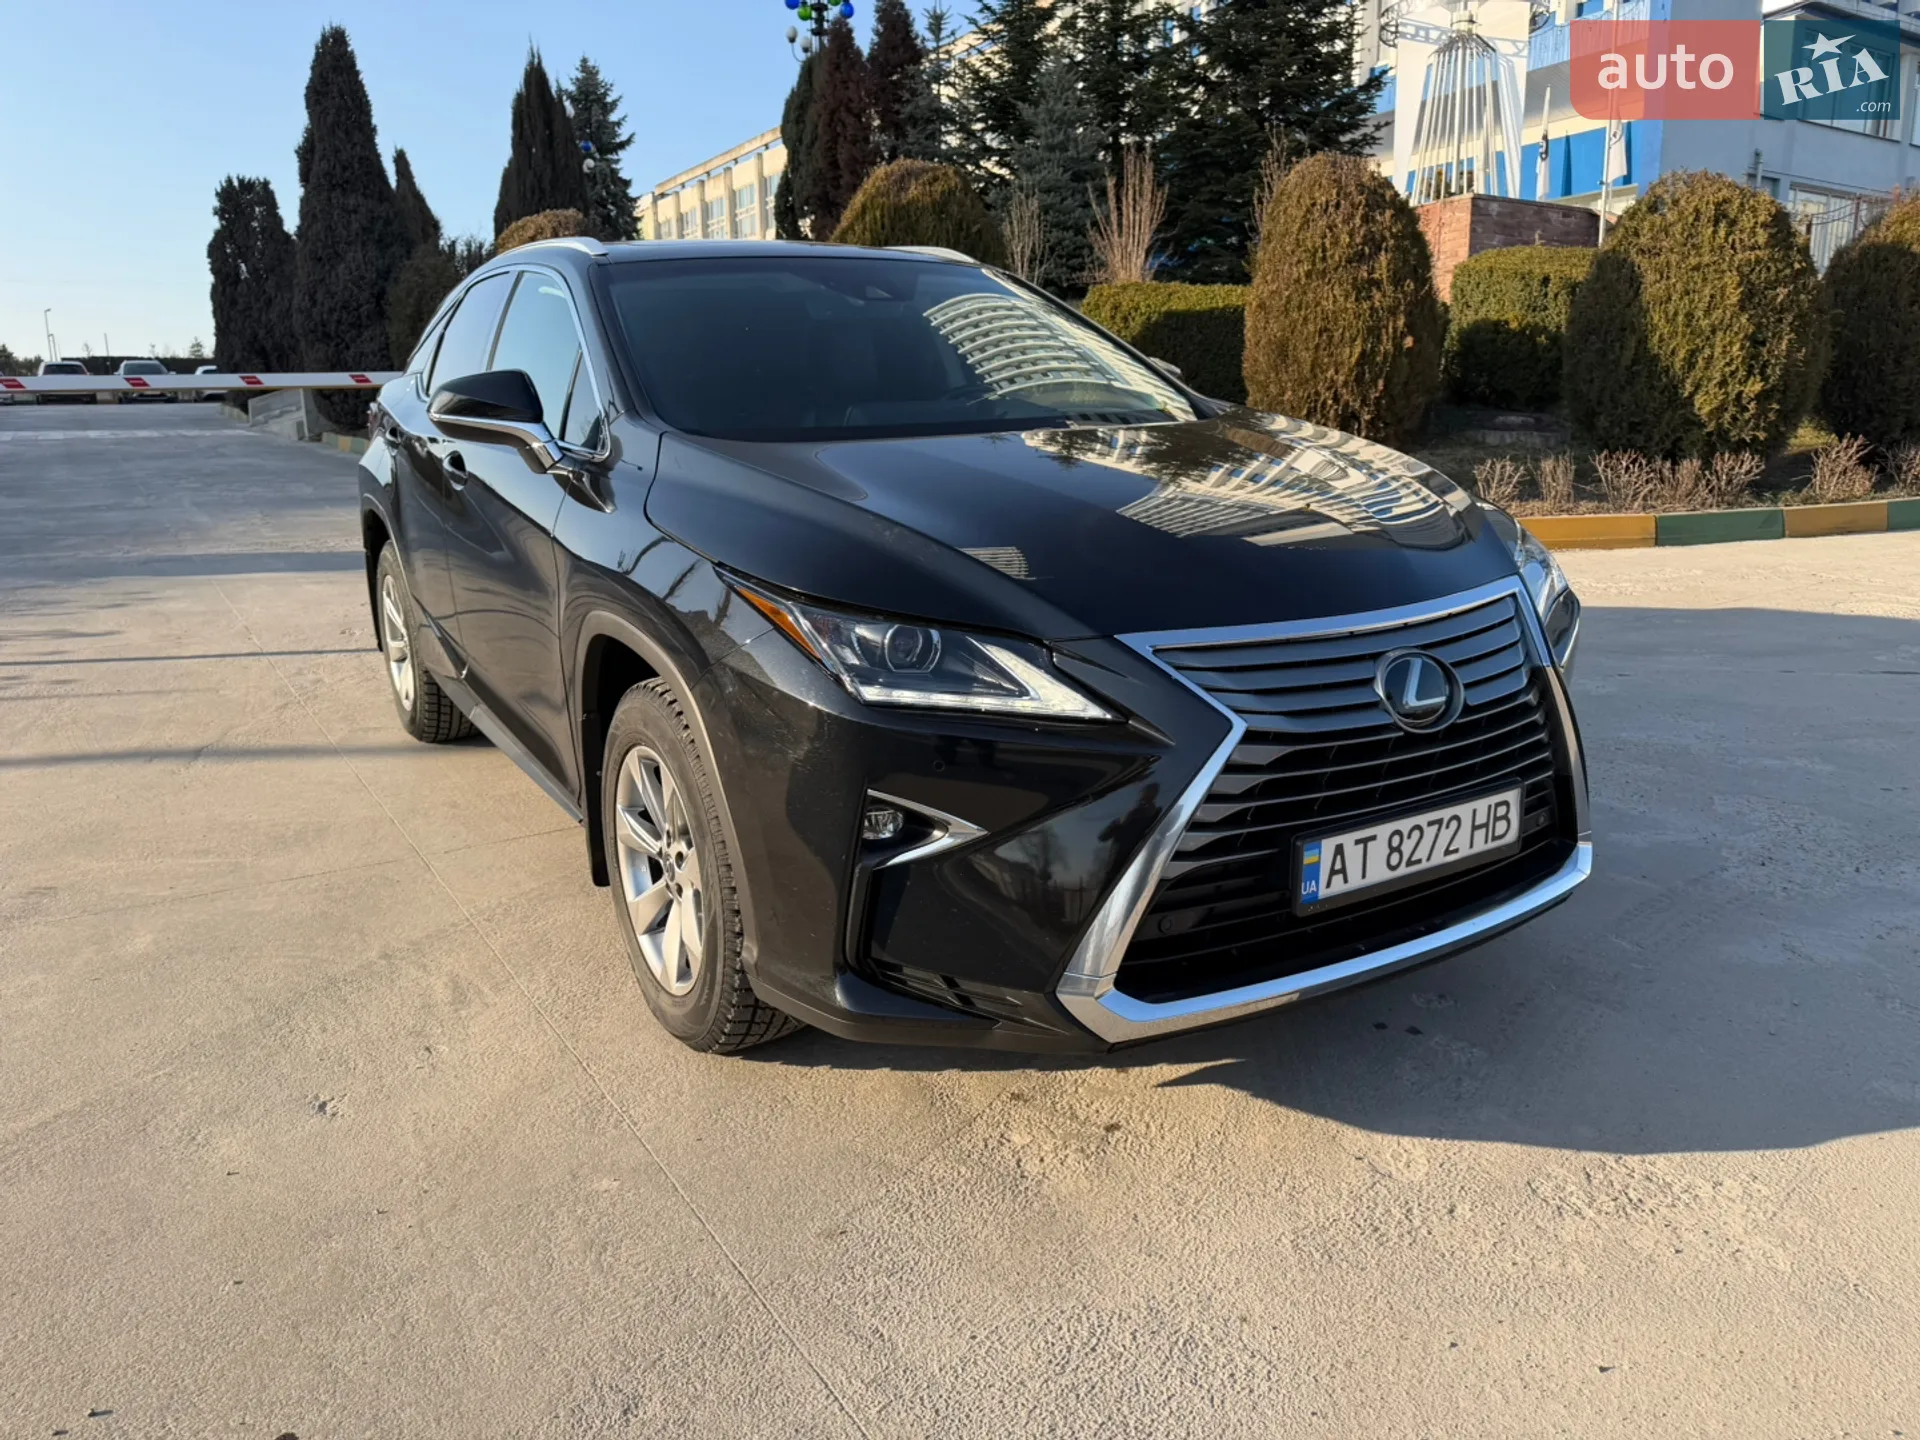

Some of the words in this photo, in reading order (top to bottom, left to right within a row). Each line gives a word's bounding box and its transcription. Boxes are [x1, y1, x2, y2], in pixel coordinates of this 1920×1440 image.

[1325, 834, 1377, 889] AT
[1385, 814, 1462, 872] 8272
[1468, 799, 1512, 850] HB
[1301, 880, 1318, 895] UA
